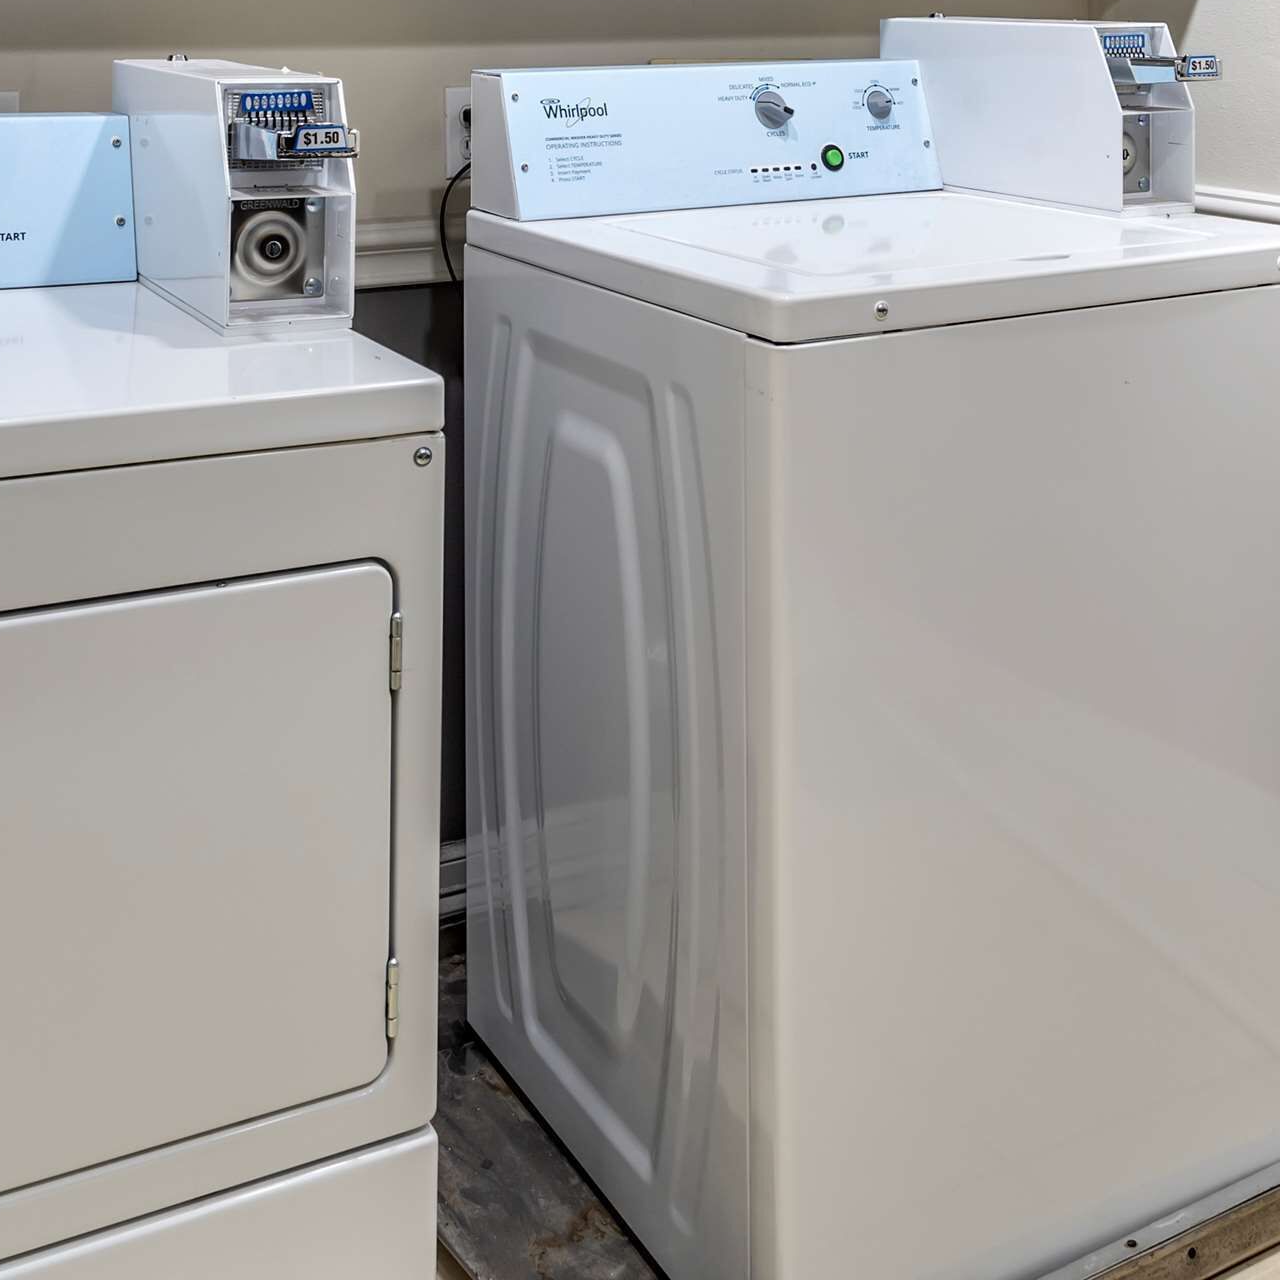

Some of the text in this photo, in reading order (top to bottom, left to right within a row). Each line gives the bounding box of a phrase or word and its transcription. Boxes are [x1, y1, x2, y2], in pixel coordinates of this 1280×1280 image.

[1191, 59, 1215, 71] $1.50
[543, 102, 608, 122] Whirlpool
[303, 131, 340, 146] $1.50
[848, 151, 869, 160] START
[240, 199, 300, 210] GREENWALD
